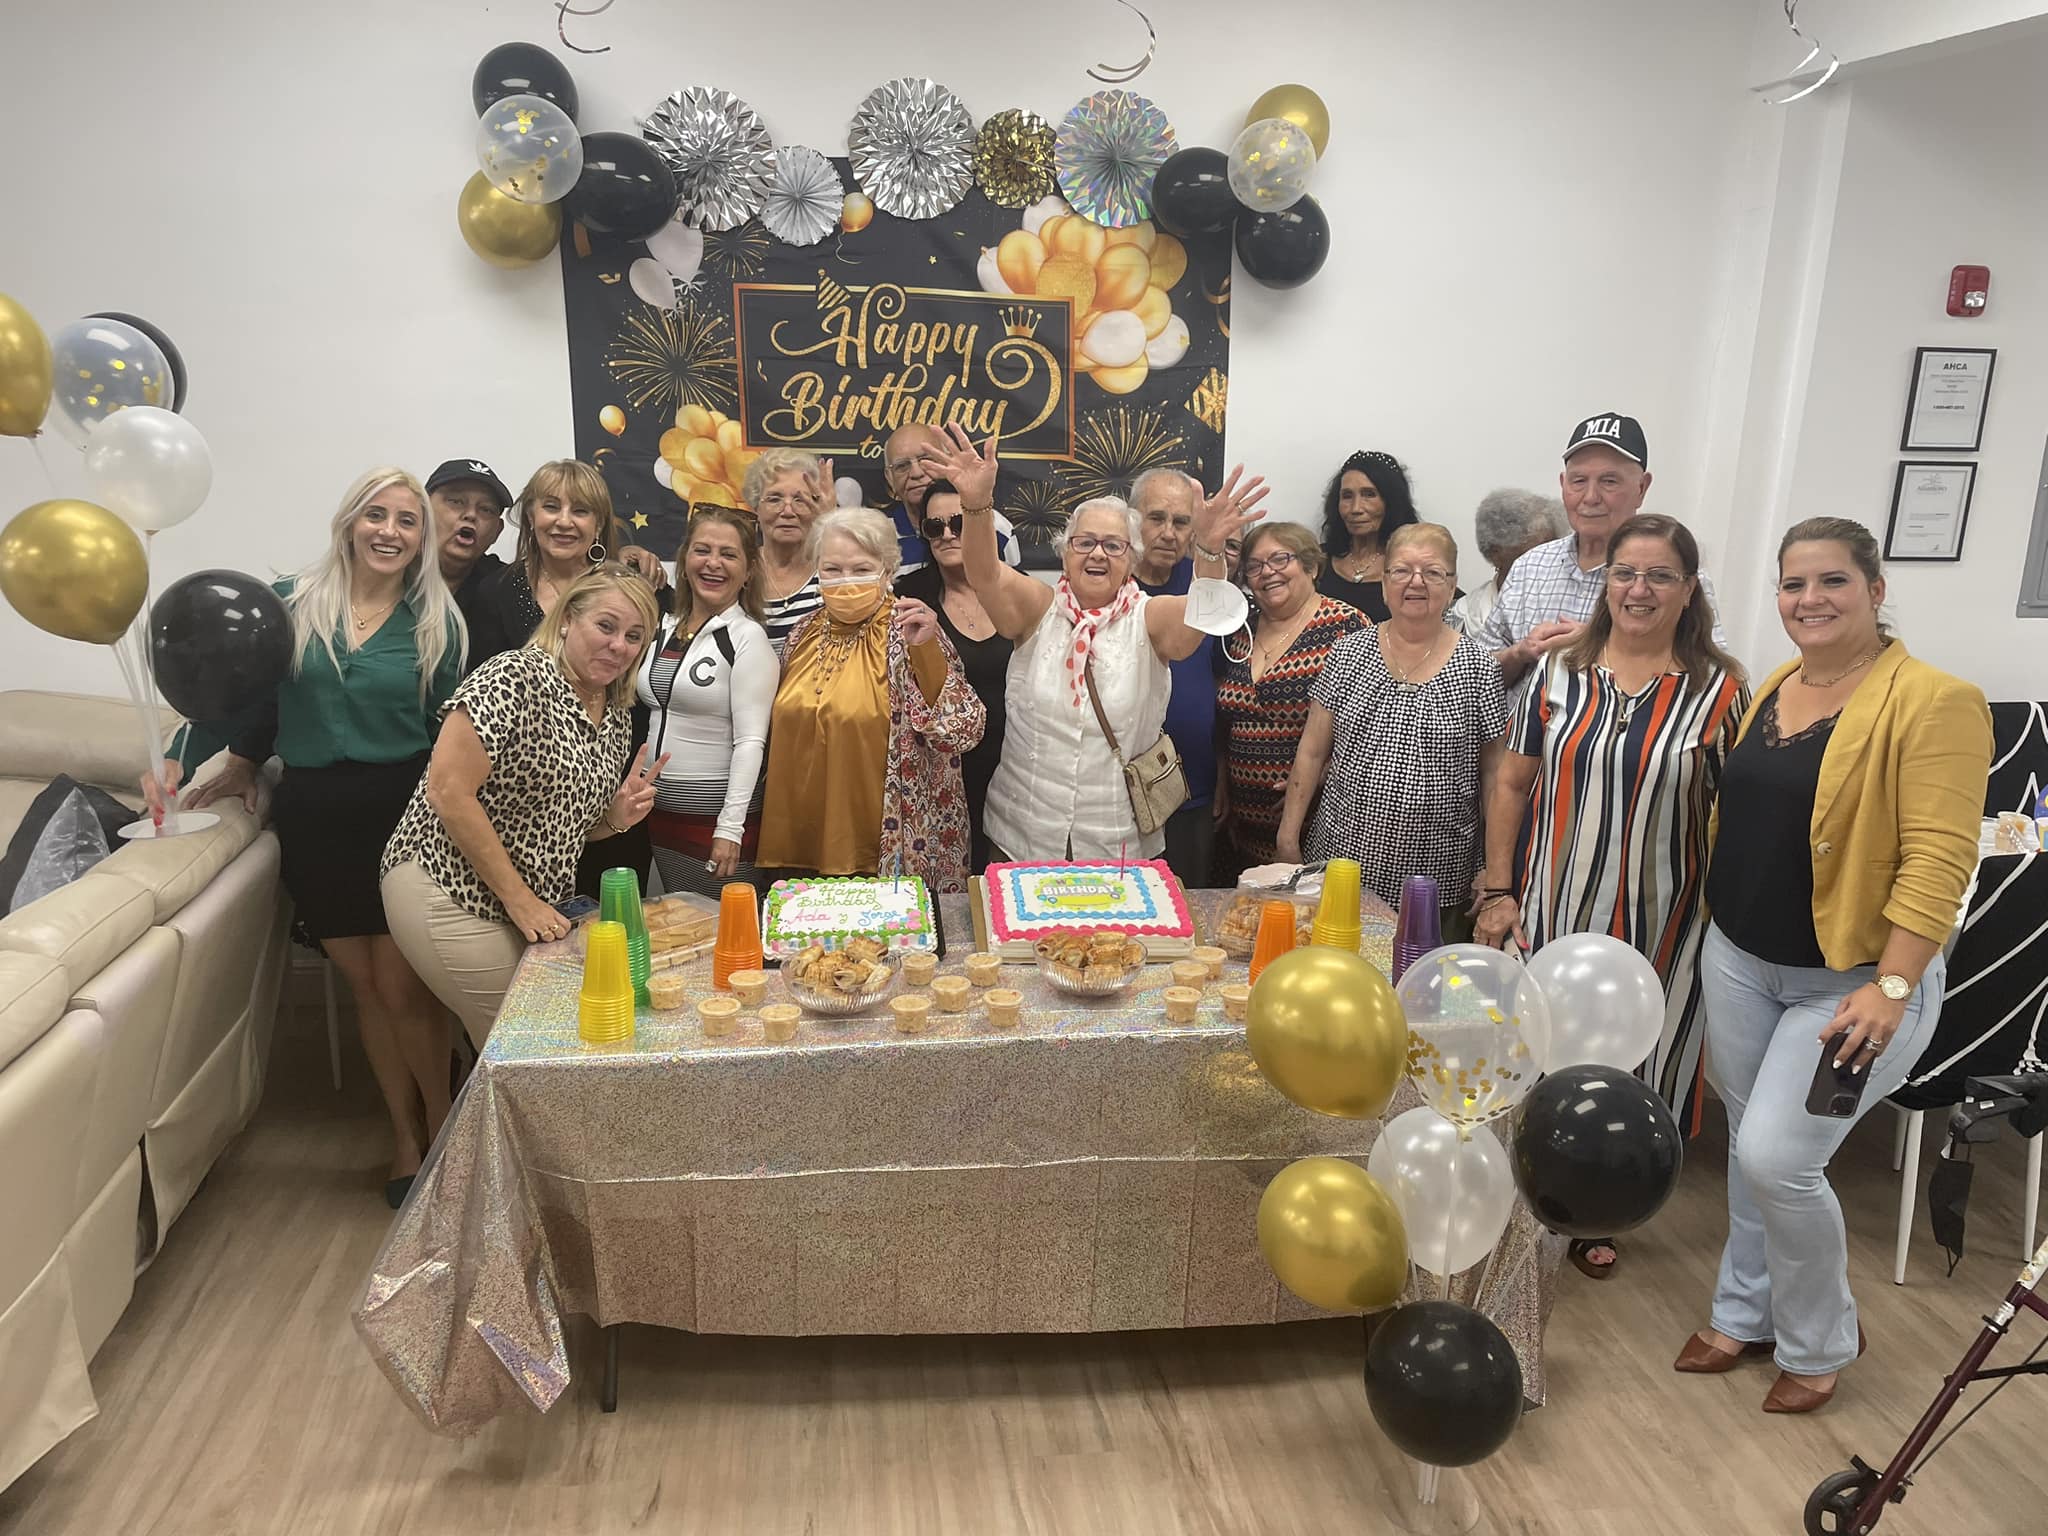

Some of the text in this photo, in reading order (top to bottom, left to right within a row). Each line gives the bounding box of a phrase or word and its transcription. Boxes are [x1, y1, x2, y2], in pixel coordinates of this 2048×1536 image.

[770, 283, 978, 388] Happy
[1943, 362, 1968, 370] AHCA
[762, 357, 1032, 444] Birthday
[1582, 418, 1621, 439] MIA
[859, 434, 885, 459] to
[689, 656, 717, 687] C
[819, 884, 877, 900] Happy
[1042, 884, 1115, 896] BIRTHDAY
[797, 894, 883, 911] Birthday
[788, 910, 831, 925] Ada
